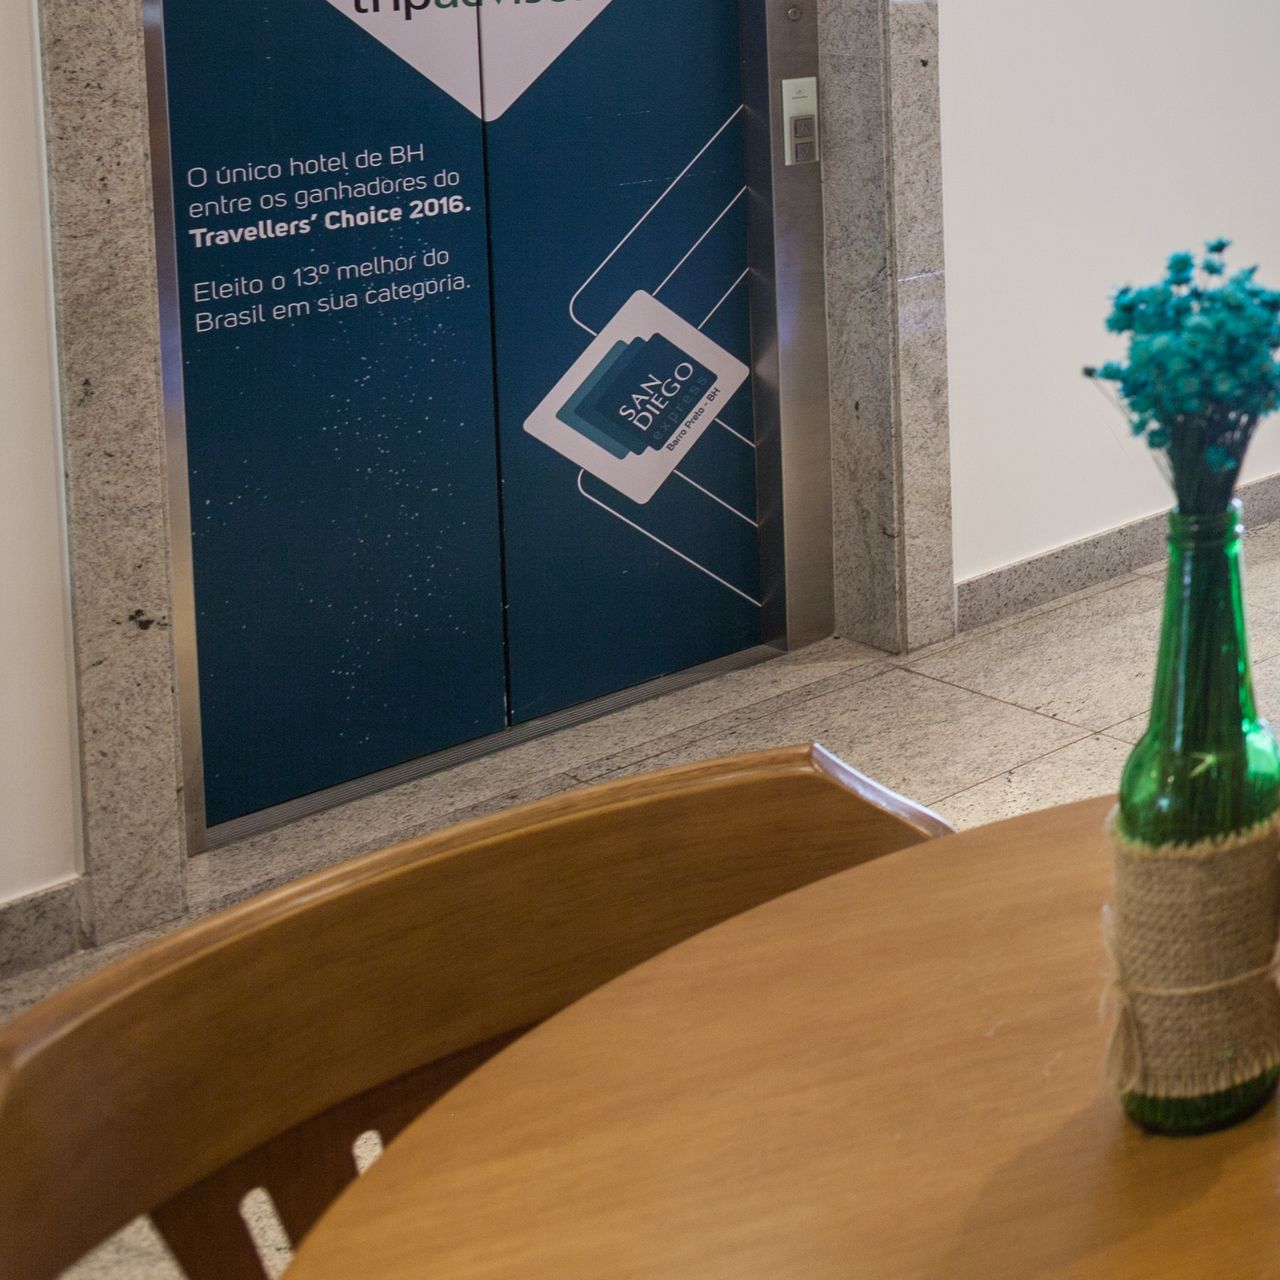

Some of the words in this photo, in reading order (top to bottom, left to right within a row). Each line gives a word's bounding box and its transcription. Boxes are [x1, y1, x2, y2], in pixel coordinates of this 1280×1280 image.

[188, 166, 207, 188] O
[216, 161, 283, 184] único
[289, 151, 349, 176] hotel
[355, 147, 383, 169] de
[390, 143, 425, 165] BH
[189, 192, 252, 218] entre
[260, 191, 288, 210] os
[295, 172, 427, 210] ganhadores
[433, 168, 460, 189] do
[190, 214, 318, 249] Travellers’
[325, 202, 403, 231] Choice
[410, 195, 472, 220] 2016.
[194, 275, 263, 303] Eleito
[271, 273, 287, 289] o
[337, 253, 416, 281] melhor
[423, 247, 449, 268] do
[196, 303, 266, 333] Brasil
[272, 298, 311, 320] em
[318, 292, 359, 313] sua
[365, 273, 471, 308] categoria.
[619, 374, 662, 421] SAN
[633, 363, 693, 431] DIEGO
[653, 377, 708, 440] express
[666, 429, 687, 451] Barro
[684, 407, 705, 429] Preto
[706, 387, 720, 402] BH
